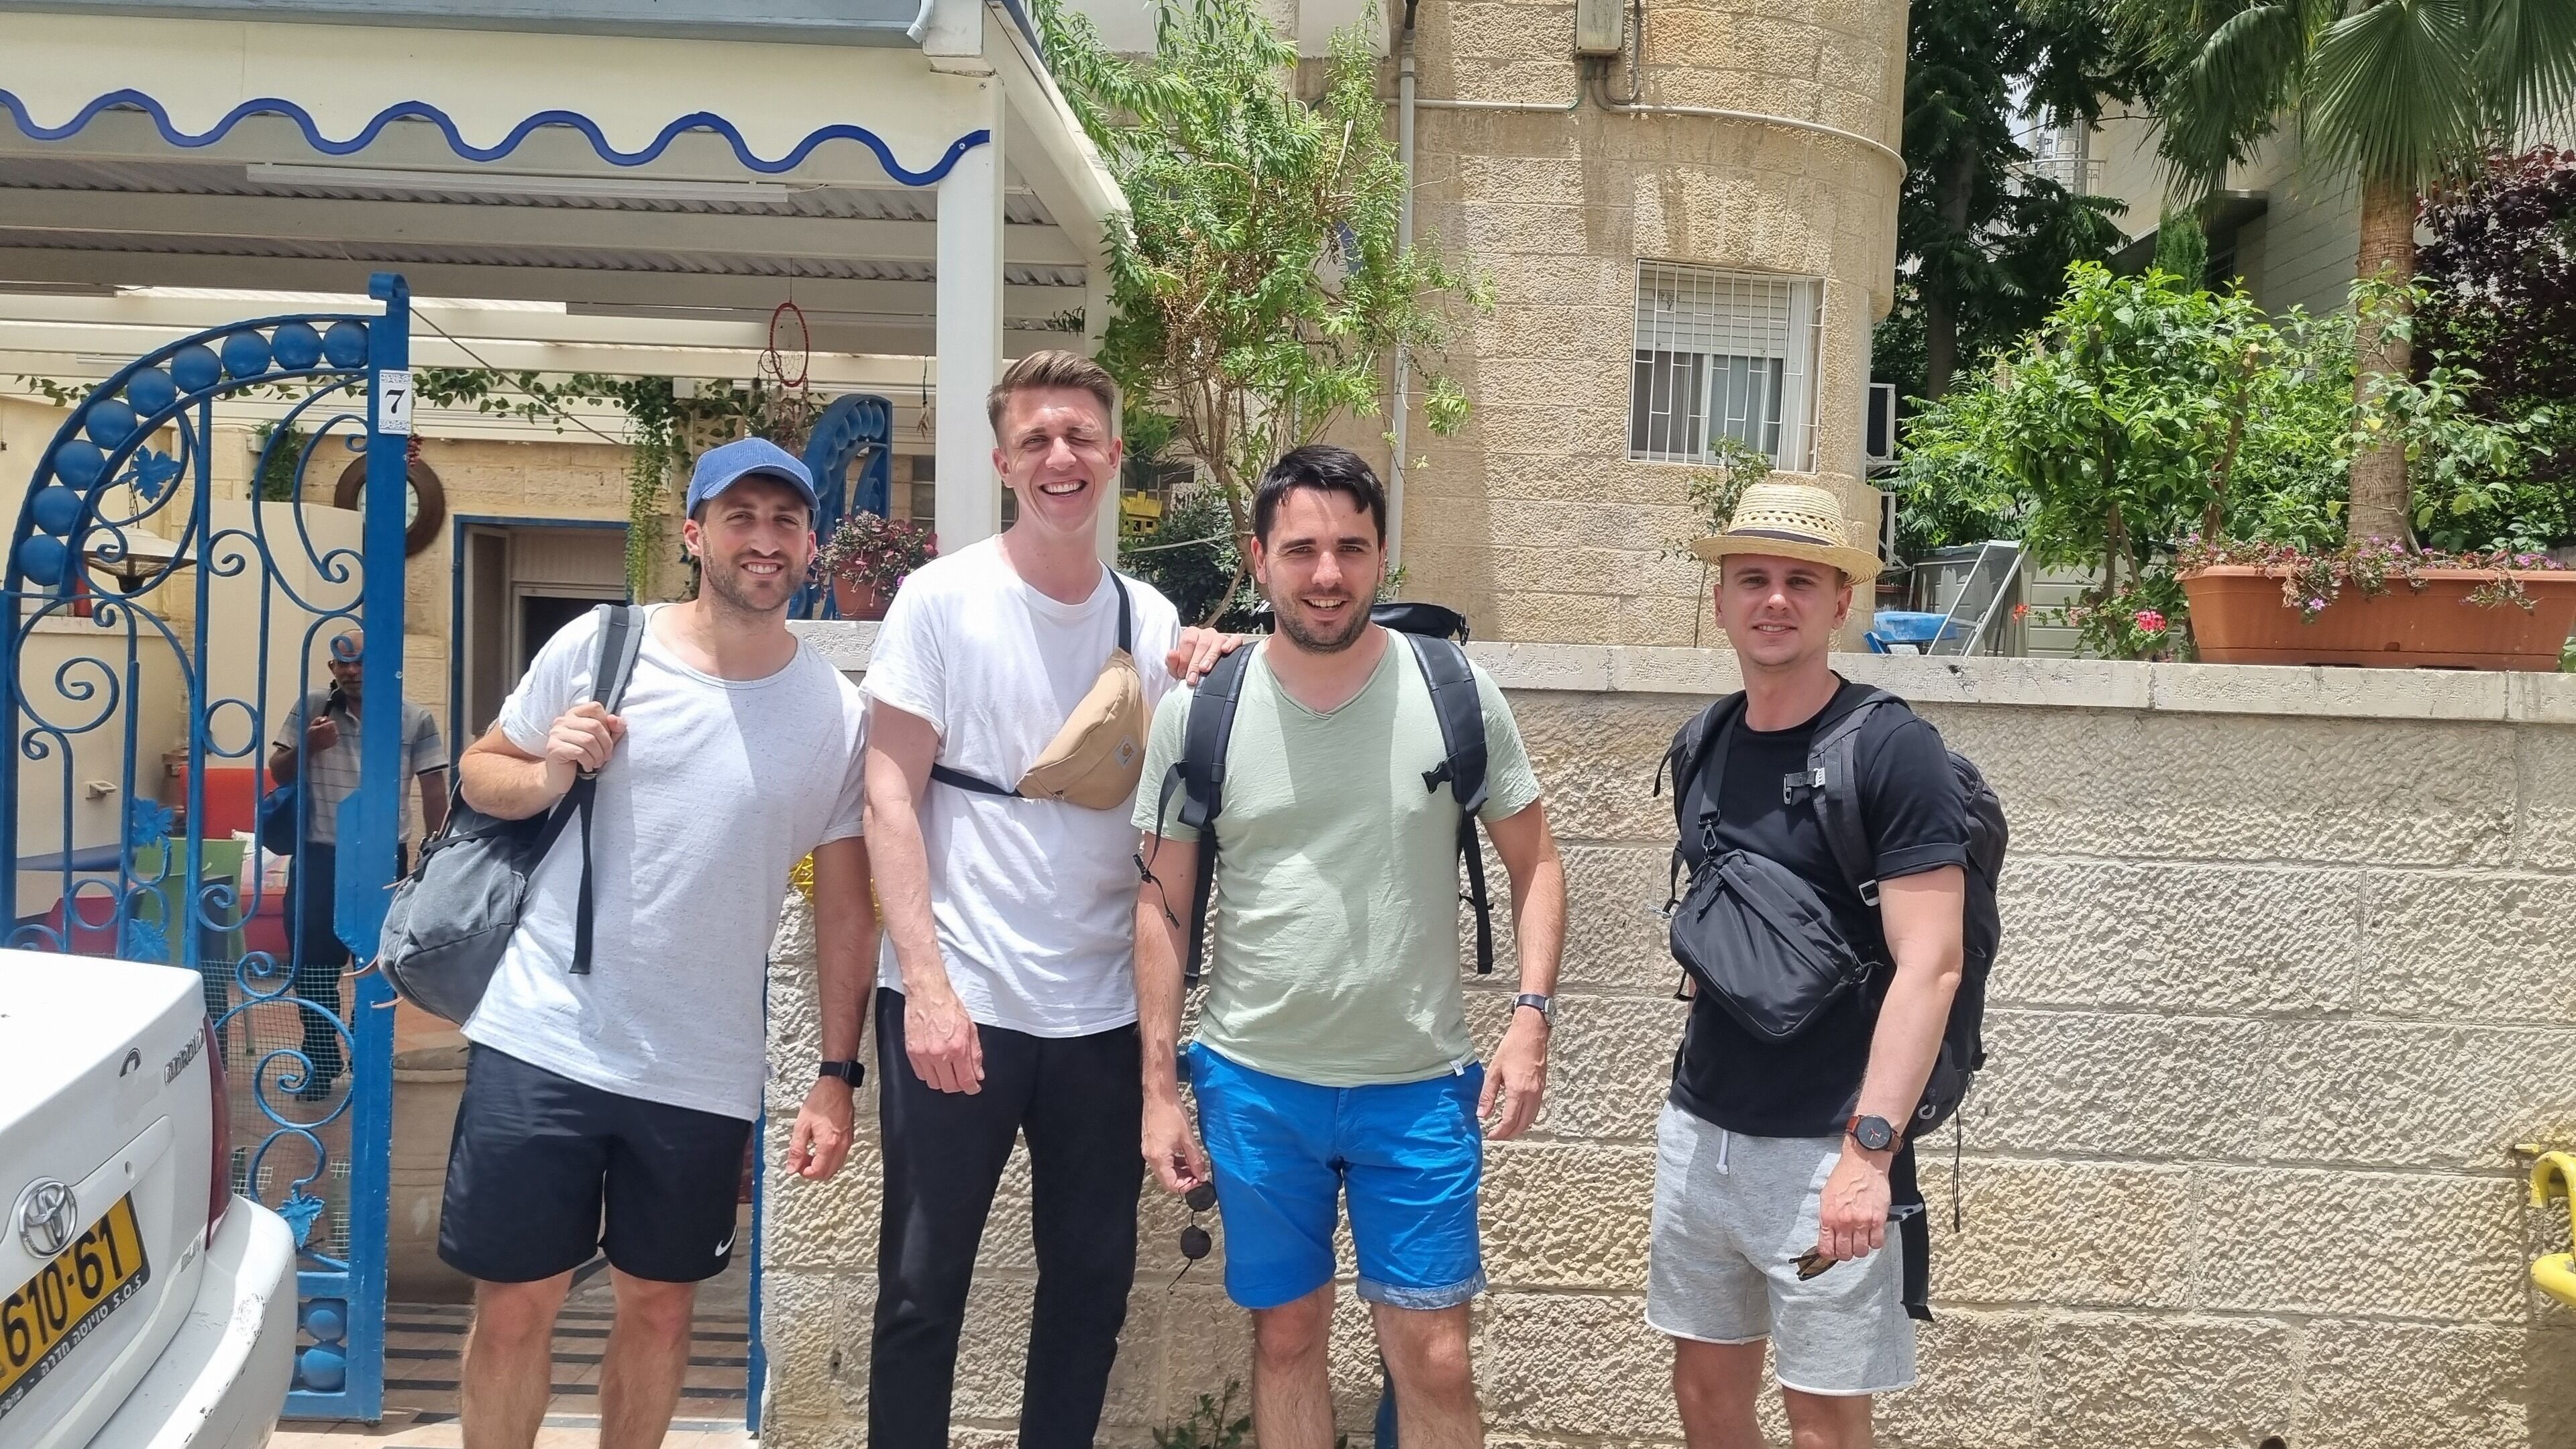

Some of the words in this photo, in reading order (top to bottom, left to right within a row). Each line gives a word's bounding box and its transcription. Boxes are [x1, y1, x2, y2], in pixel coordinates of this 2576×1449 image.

[384, 389, 406, 414] 7
[113, 1274, 142, 1309] S.O.S
[40, 1341, 70, 1376] חדרה
